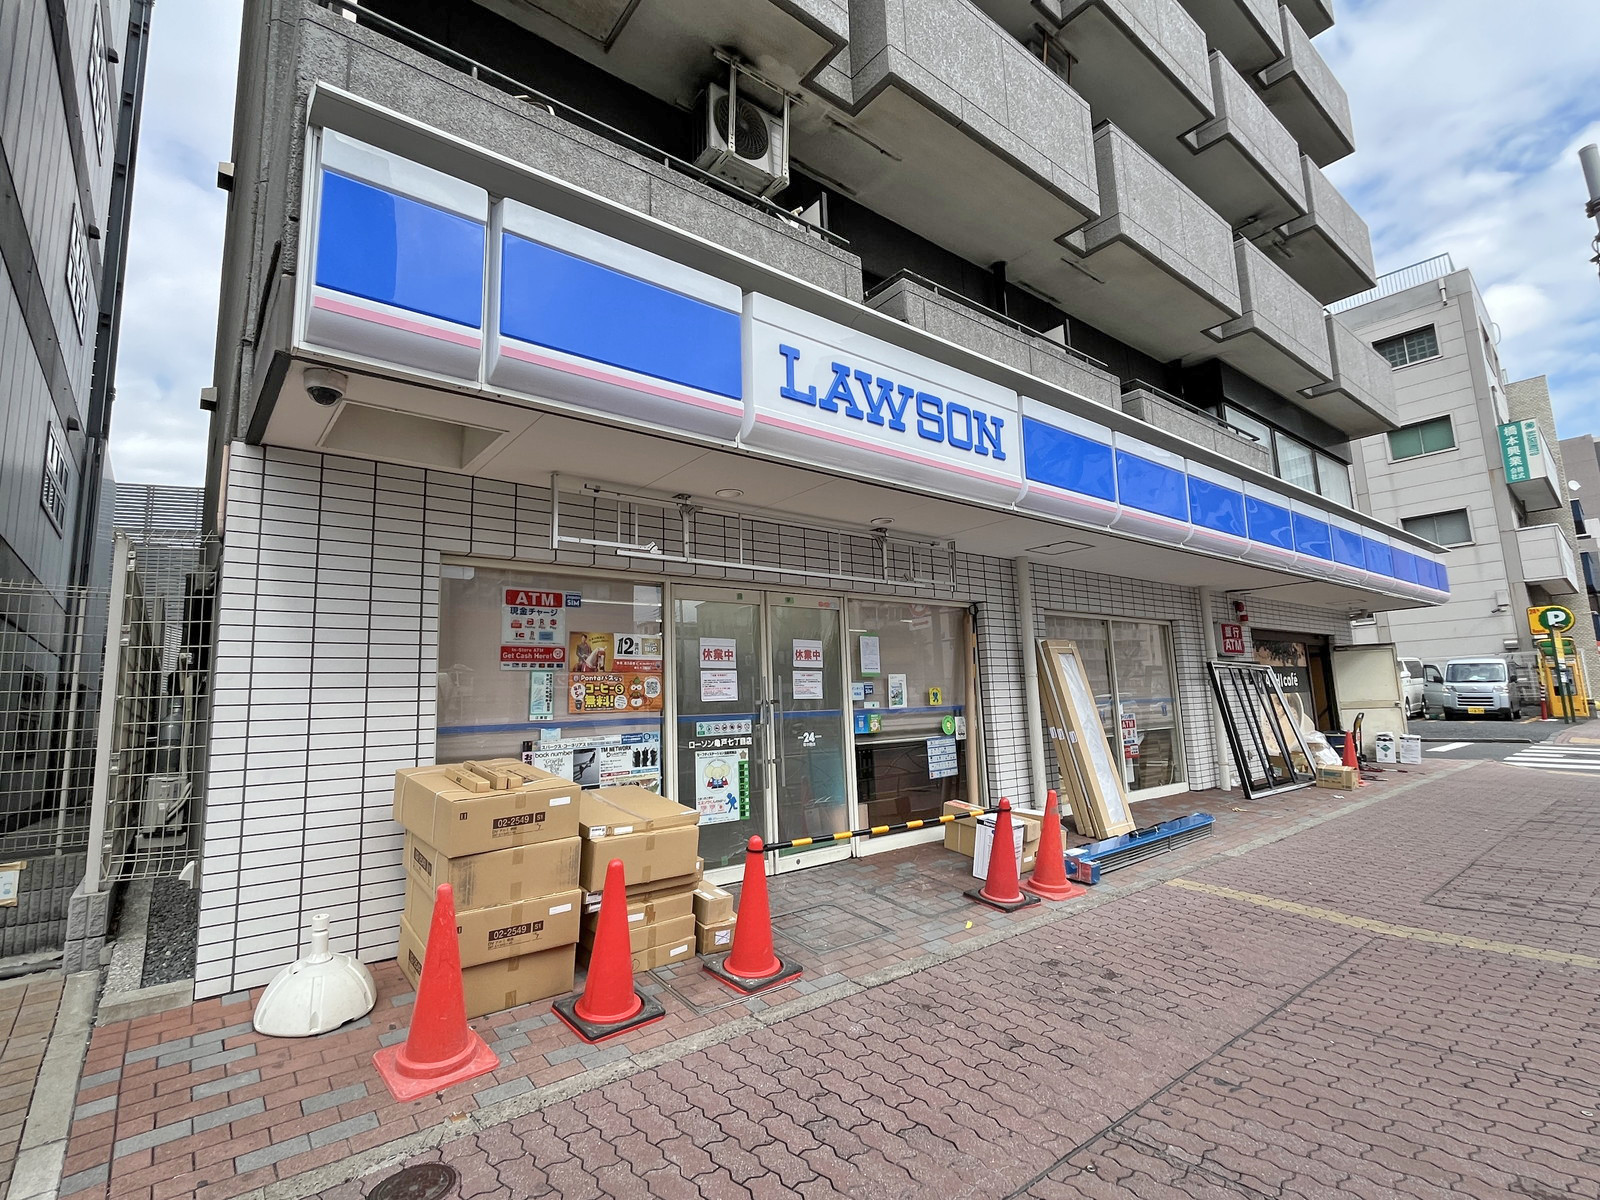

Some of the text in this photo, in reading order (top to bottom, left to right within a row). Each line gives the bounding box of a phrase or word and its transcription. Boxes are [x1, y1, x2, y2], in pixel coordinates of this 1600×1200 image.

[779, 343, 1007, 461] LAWSON
[515, 591, 554, 607] ATM
[509, 606, 558, 617] 現金チャージ
[1546, 610, 1566, 626] P
[616, 637, 635, 655] 12
[1225, 639, 1243, 651] ATM
[702, 648, 734, 662] 休業中
[794, 649, 821, 662] 休業中
[1122, 721, 1134, 729] ATM
[688, 737, 753, 749] ローソン亀戸七丁目店
[803, 732, 816, 743] 24
[534, 750, 573, 759] back number
[497, 815, 530, 828] 02-2549
[493, 925, 527, 940] 02-2549
